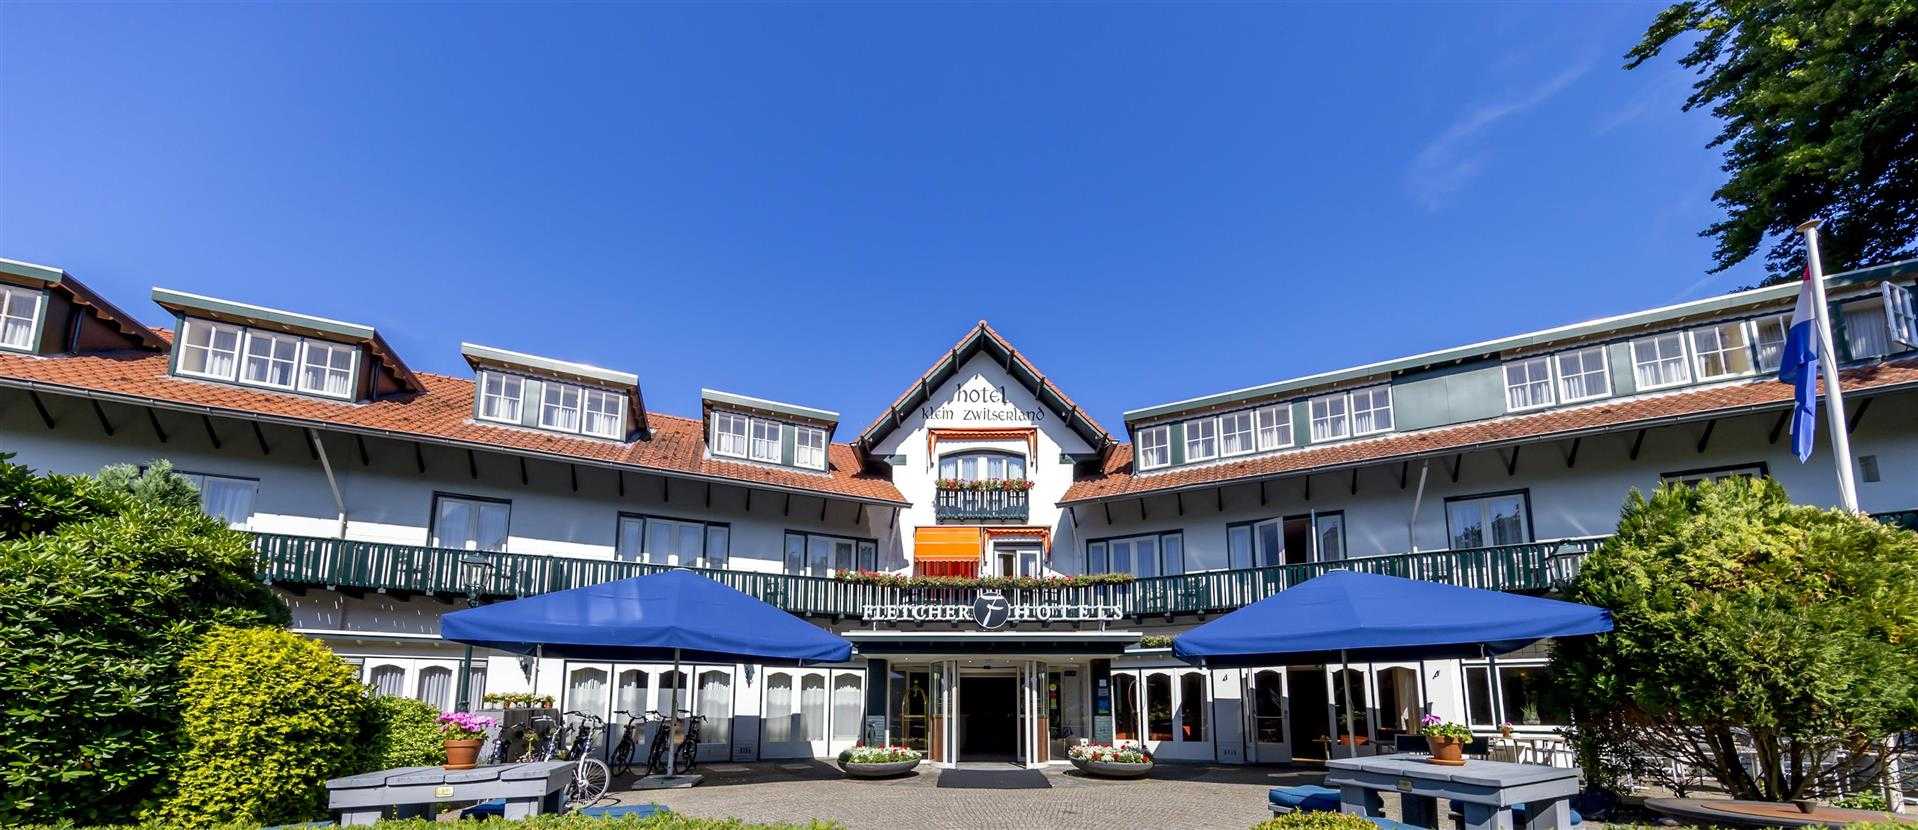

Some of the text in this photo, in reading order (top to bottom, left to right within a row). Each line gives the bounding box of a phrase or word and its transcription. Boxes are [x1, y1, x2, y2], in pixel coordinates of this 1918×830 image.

[956, 383, 1007, 406] hotel
[863, 605, 974, 621] FLETCHER
[1012, 605, 1124, 621] HOTELS
